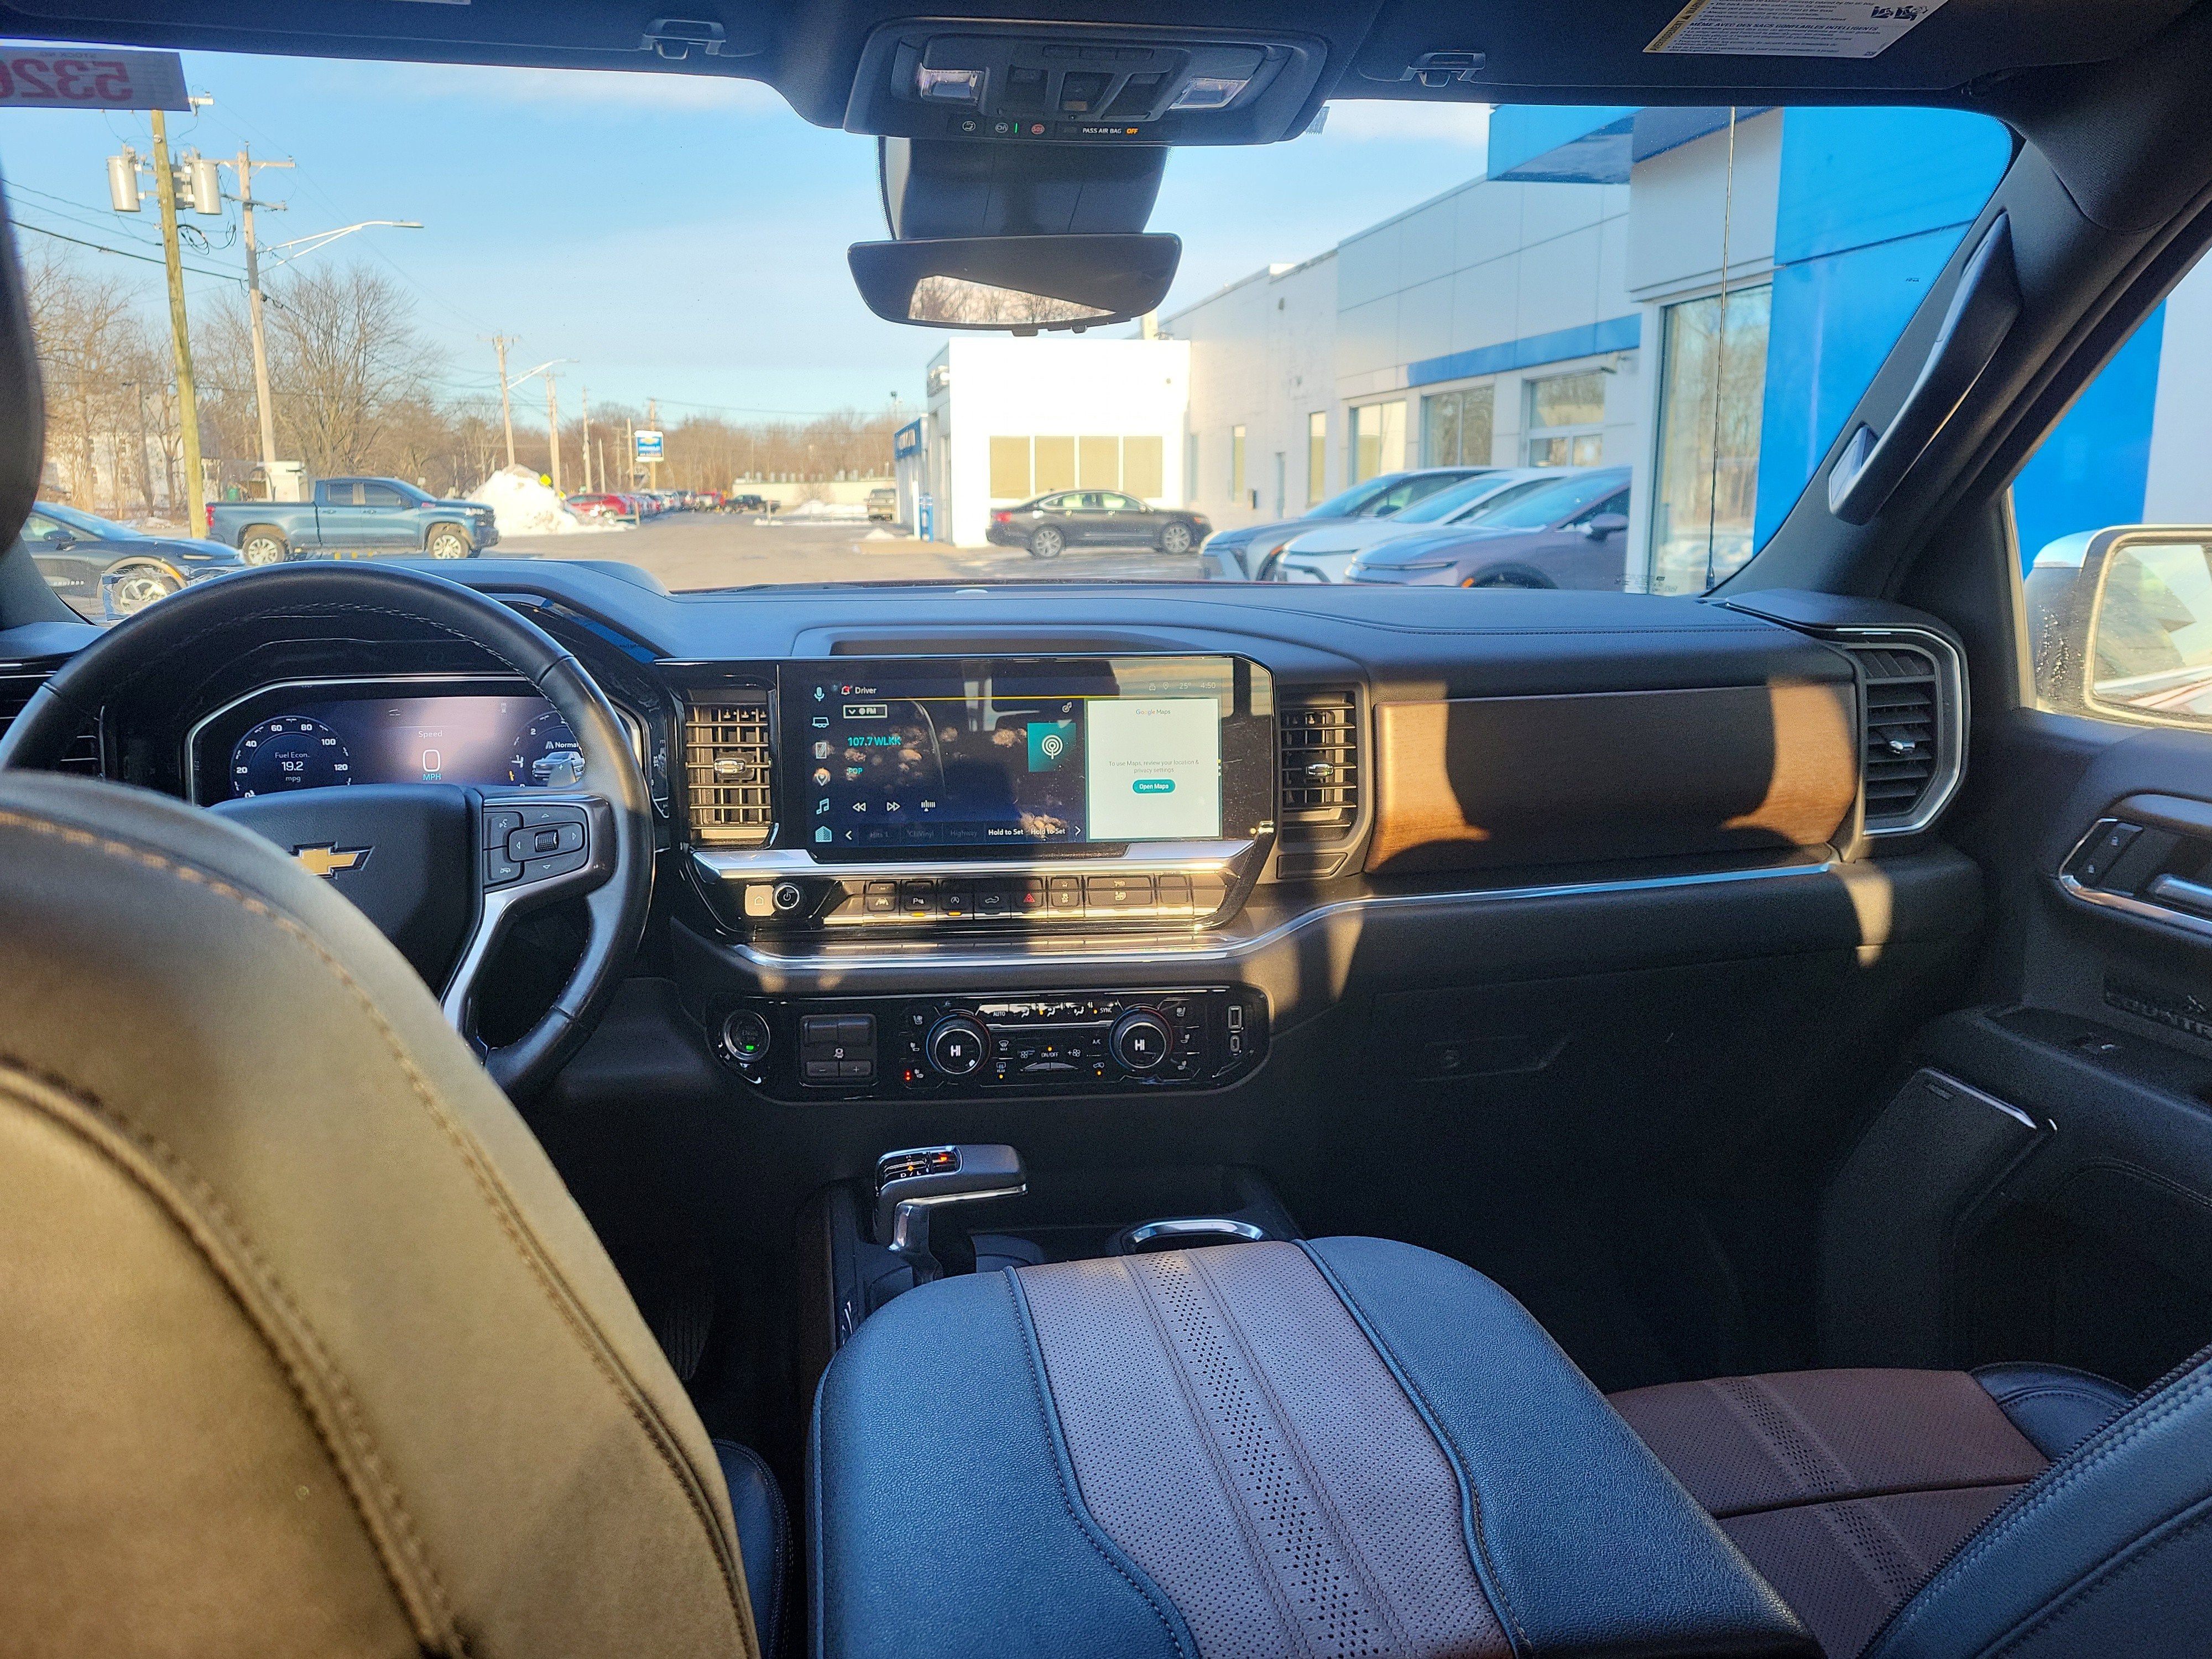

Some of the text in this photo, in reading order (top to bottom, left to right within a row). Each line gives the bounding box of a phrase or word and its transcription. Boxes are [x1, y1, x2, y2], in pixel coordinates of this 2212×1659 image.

[418, 730, 443, 739] Speed
[848, 735, 901, 747] 107.7 WLKK
[281, 761, 304, 771] 19.2
[422, 749, 441, 772] 0
[950, 1045, 961, 1057] HI
[1134, 1039, 1145, 1051] HI
